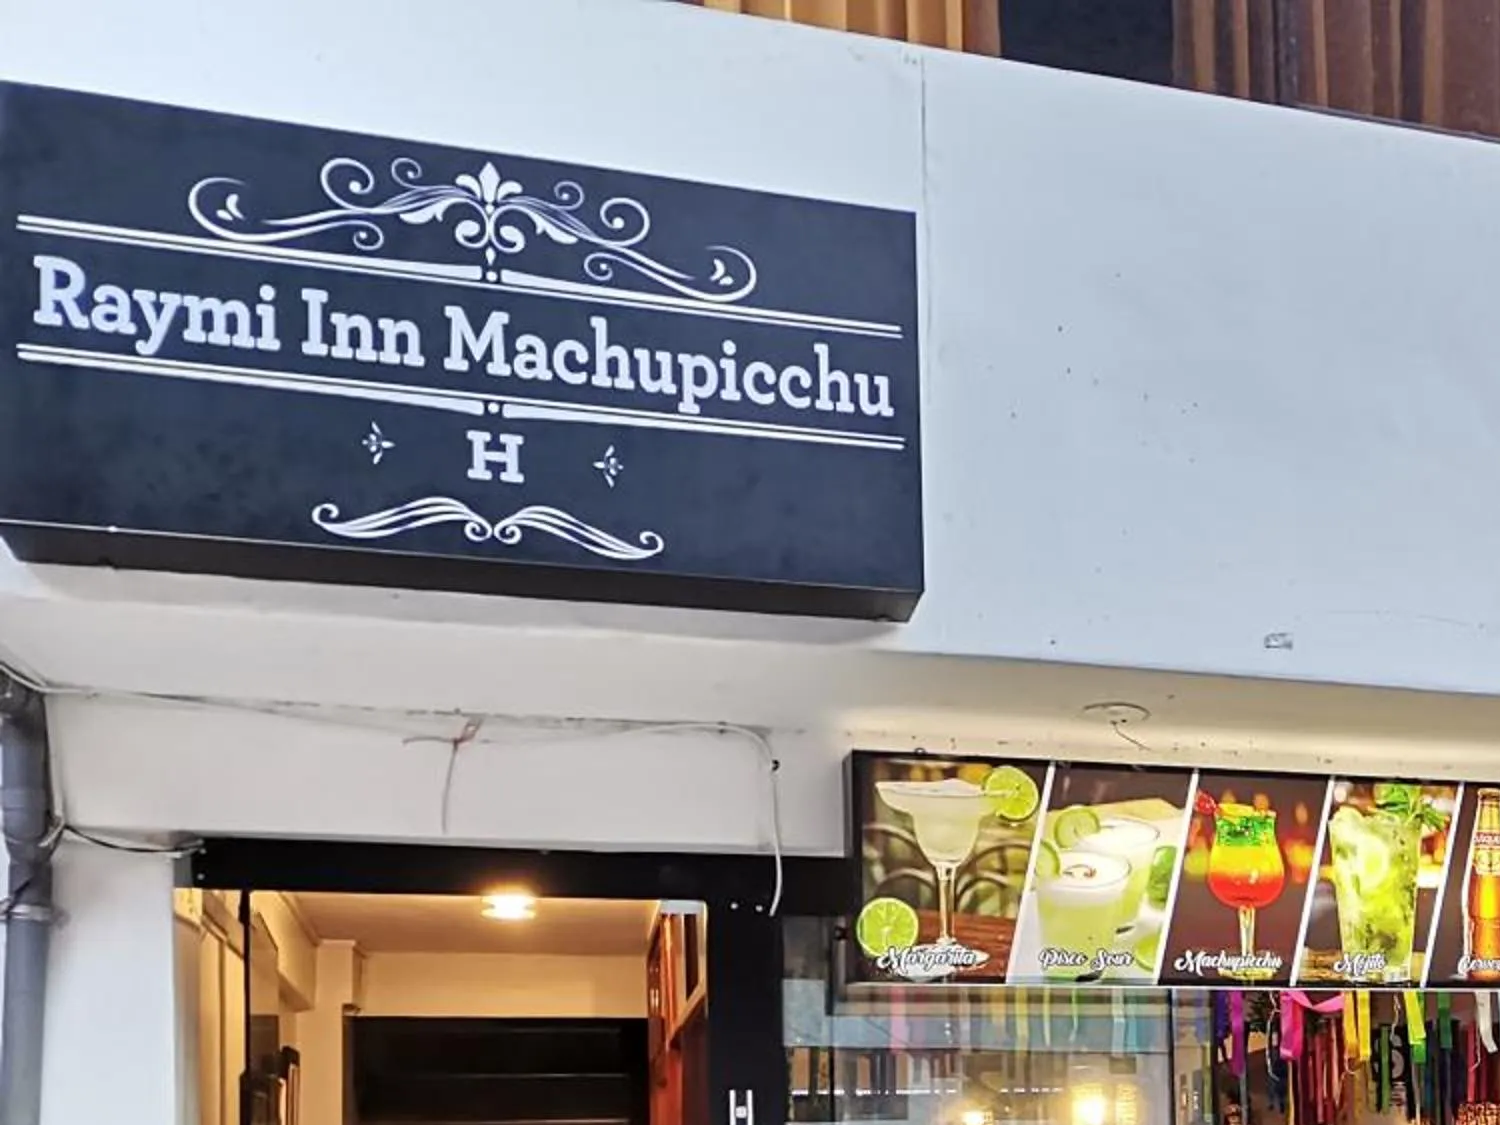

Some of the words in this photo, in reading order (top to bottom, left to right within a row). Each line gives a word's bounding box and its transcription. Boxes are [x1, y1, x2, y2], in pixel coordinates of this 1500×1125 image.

[33, 254, 281, 355] Raymi
[302, 287, 425, 368] Inn
[444, 305, 895, 419] Machupicchu
[467, 432, 524, 484] H
[877, 947, 977, 970] Margarita
[1039, 949, 1088, 969] Pisco
[1092, 949, 1134, 971] Sour
[1174, 950, 1283, 976] Machupicchu
[1333, 952, 1386, 975] Mojito
